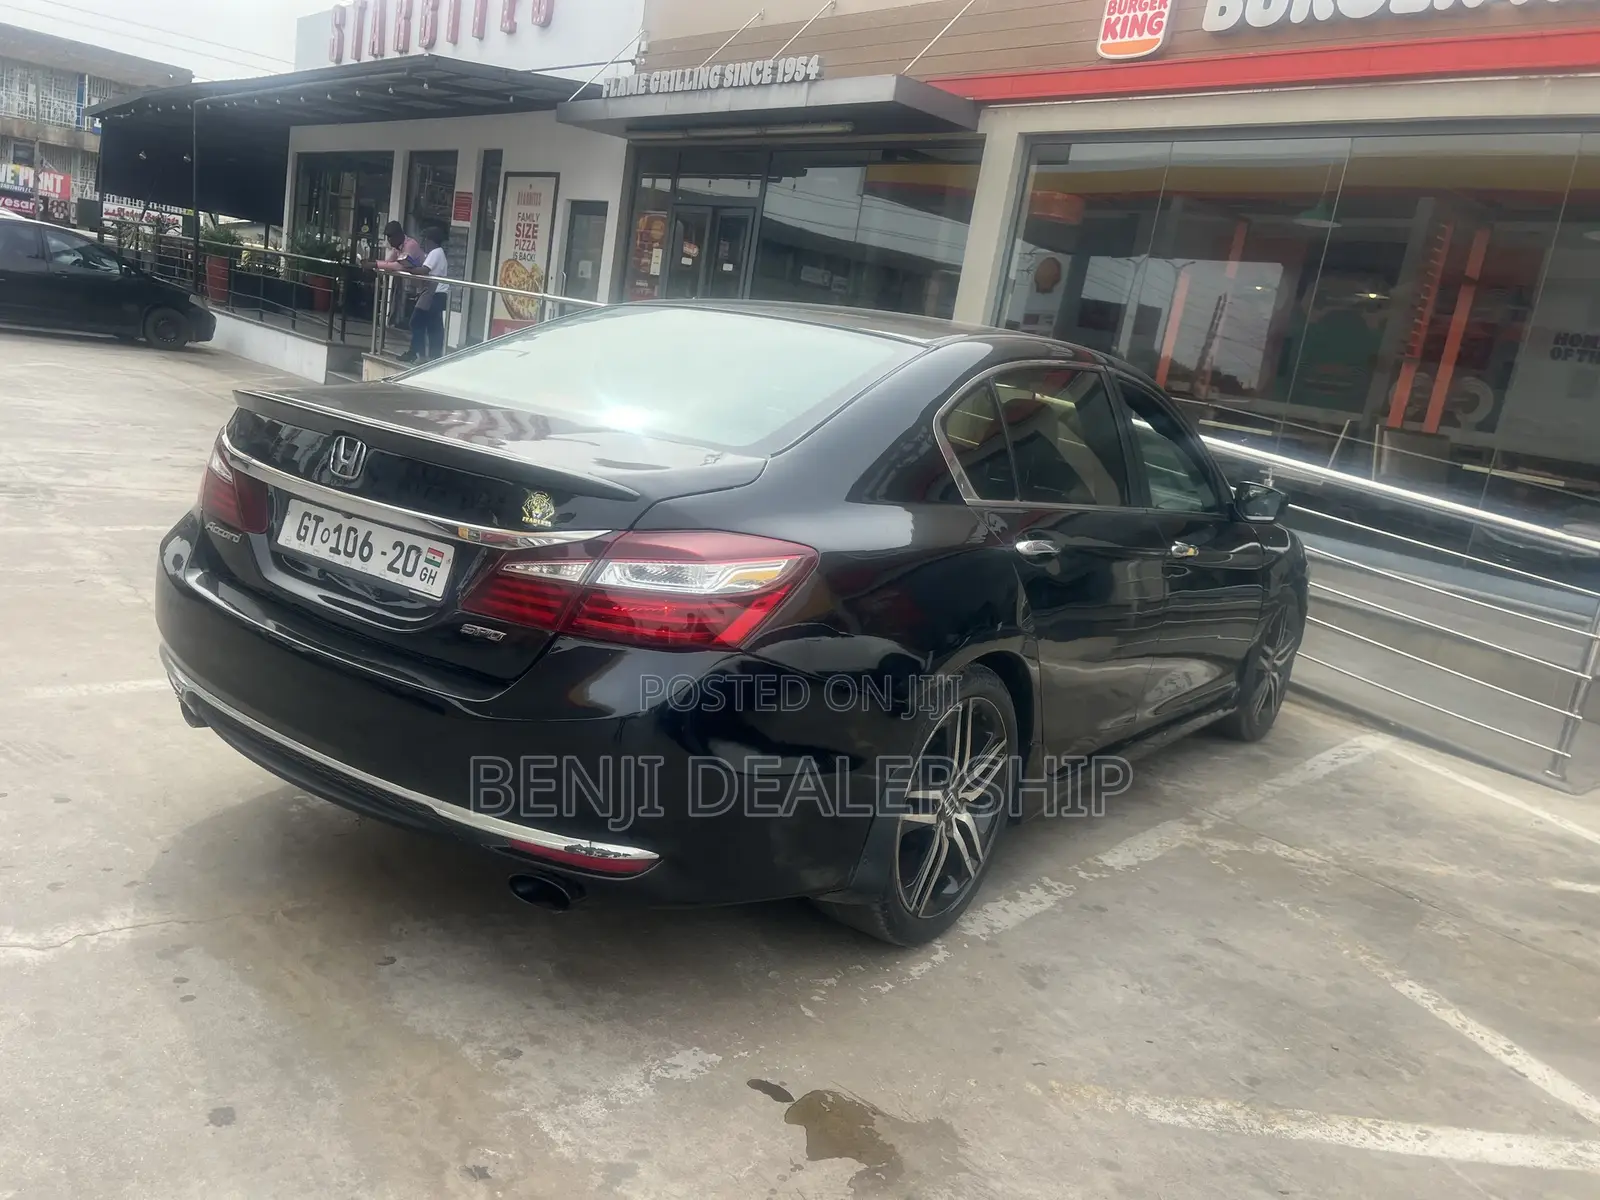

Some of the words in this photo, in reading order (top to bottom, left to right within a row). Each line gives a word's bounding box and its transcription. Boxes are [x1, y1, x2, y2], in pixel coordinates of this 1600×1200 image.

[1102, 11, 1165, 41] KING
[602, 73, 647, 98] FLAME
[650, 65, 721, 93] GRILLING
[723, 59, 773, 87] SINCE
[777, 54, 820, 83] 1954
[517, 212, 541, 222] FAMILY
[515, 223, 539, 239] SIZE
[514, 239, 536, 252] PIZZA
[419, 567, 438, 586] GH
